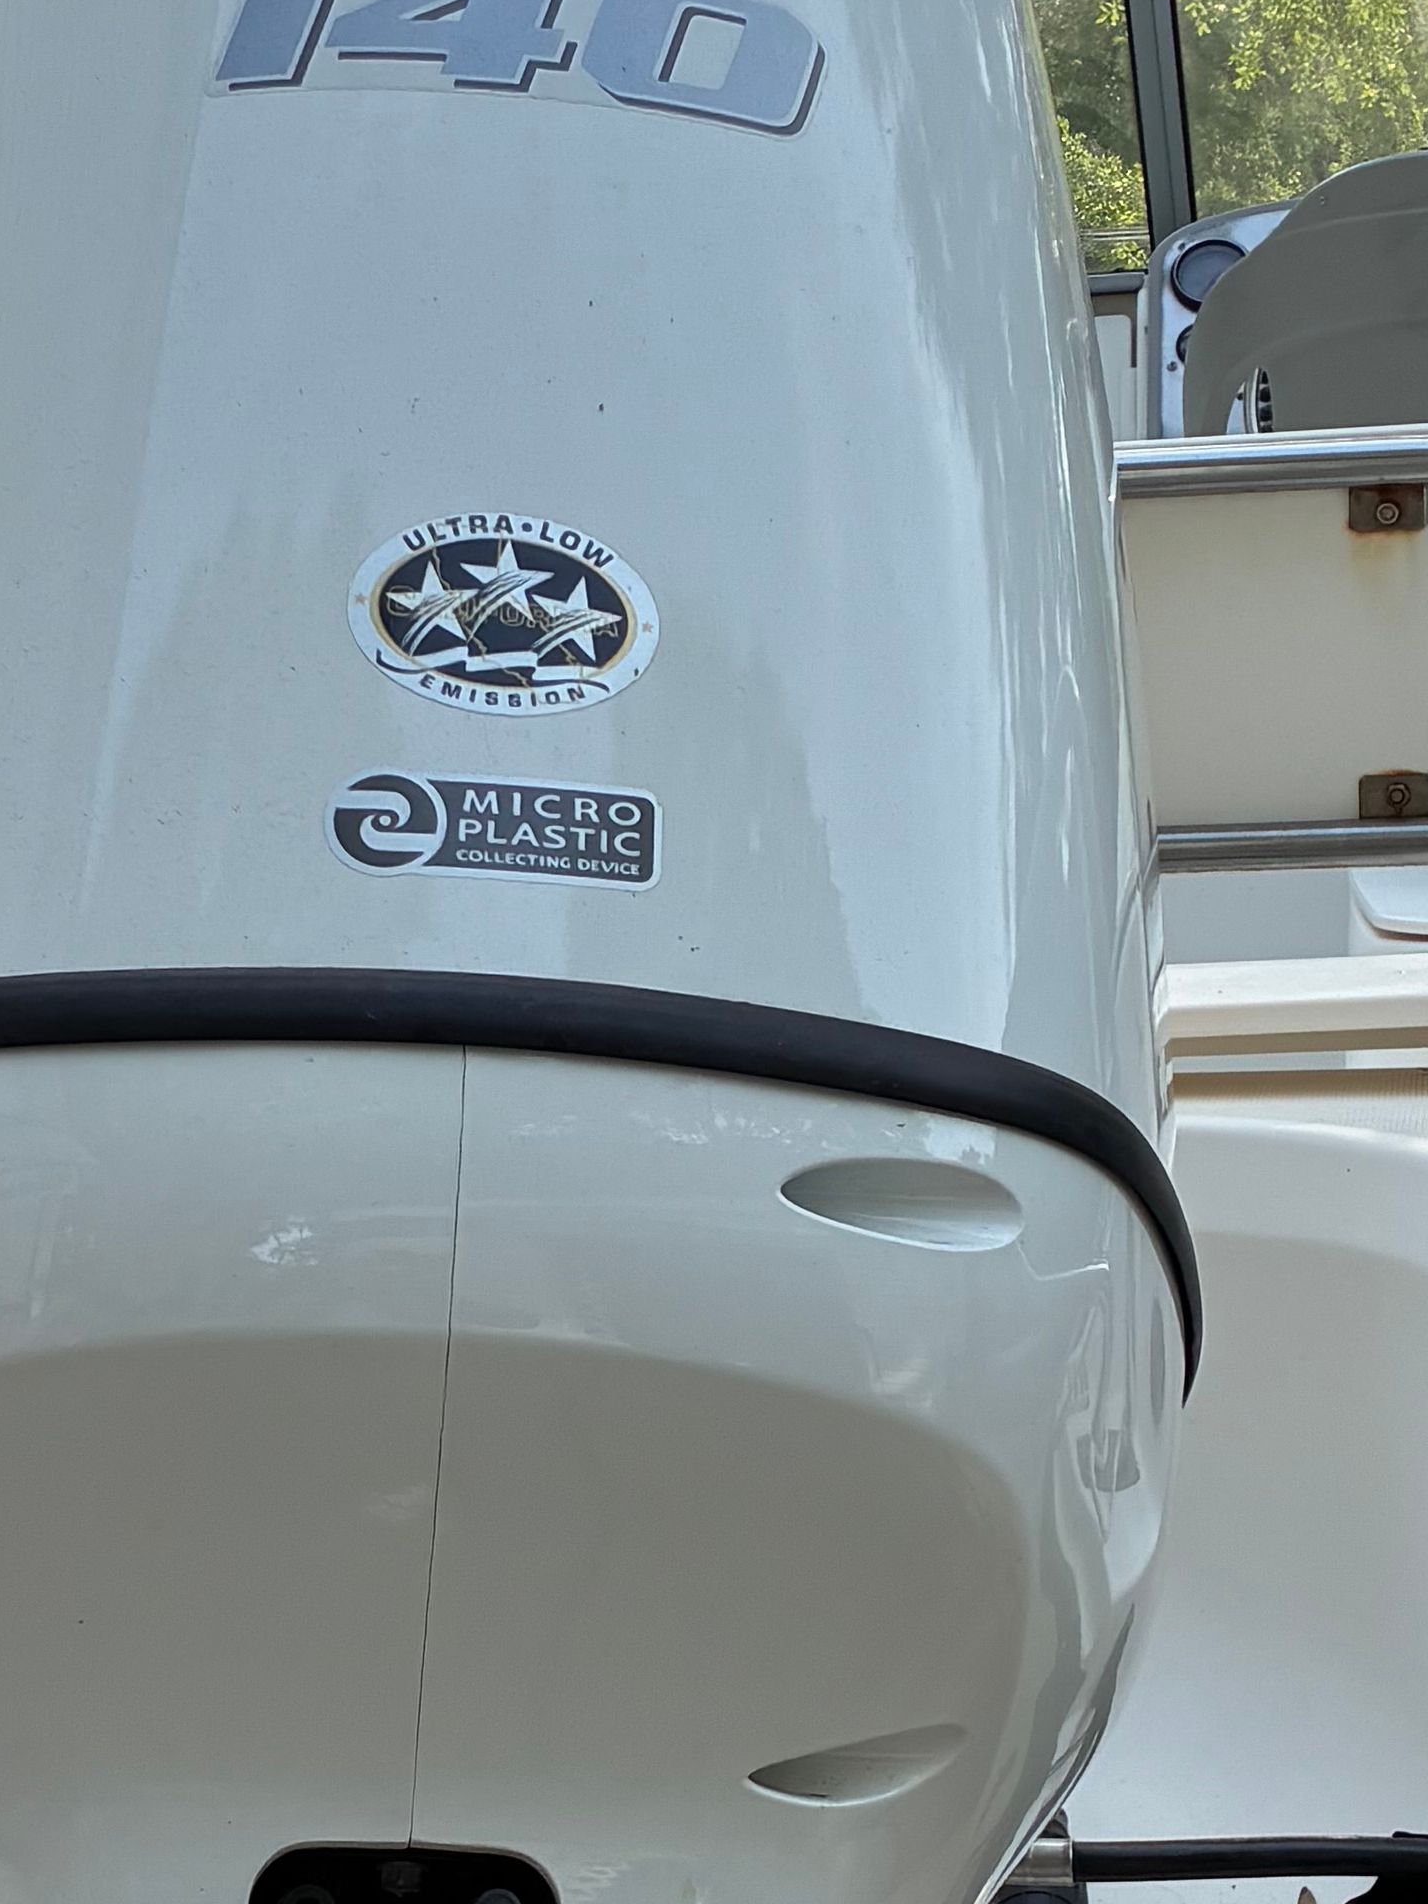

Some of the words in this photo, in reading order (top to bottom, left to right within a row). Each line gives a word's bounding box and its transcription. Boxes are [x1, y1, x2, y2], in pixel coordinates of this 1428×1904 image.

[419, 673, 586, 709] EMISSION
[462, 788, 642, 827] MICRO
[457, 818, 642, 857] PLASTIC
[455, 848, 571, 870] COLLECTING
[576, 857, 641, 876] DEVICE
